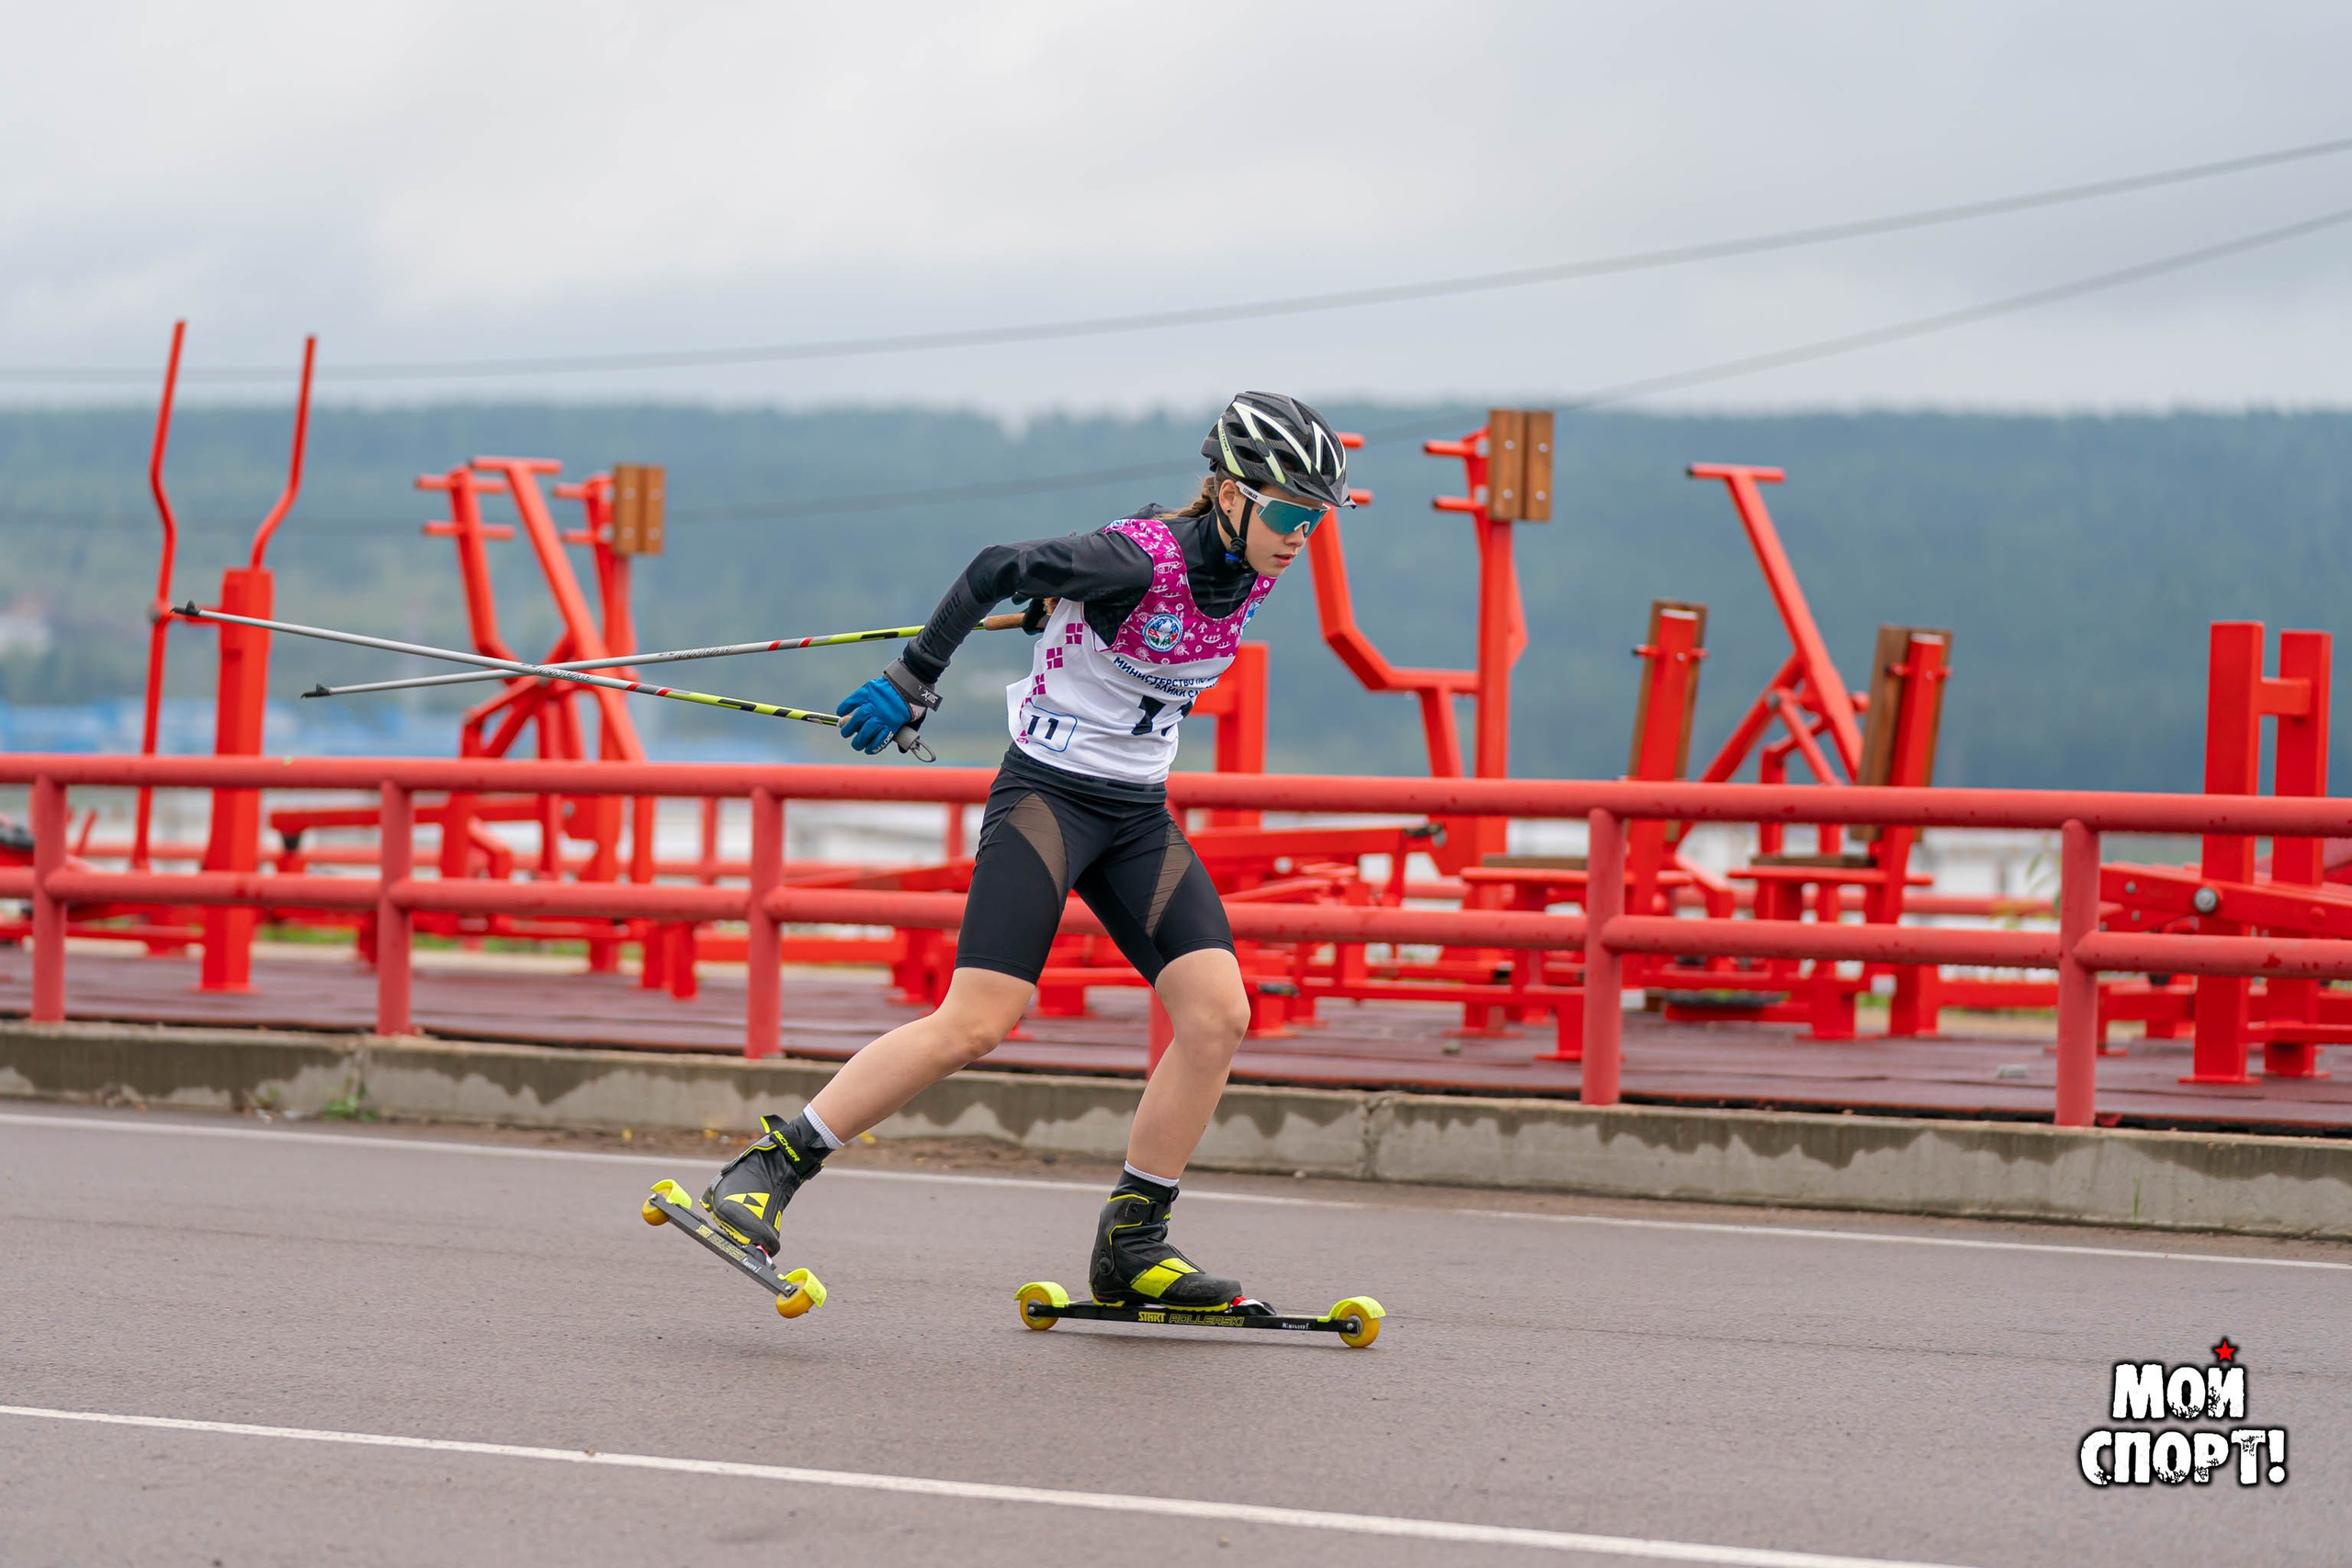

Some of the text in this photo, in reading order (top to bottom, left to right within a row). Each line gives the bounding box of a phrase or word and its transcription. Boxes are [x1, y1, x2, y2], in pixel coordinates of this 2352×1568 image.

[1113, 657, 1194, 687] МИНИСТЕРСТВО
[1027, 715, 1059, 740] 11
[1138, 1312, 1245, 1326] START ROLLERSKI
